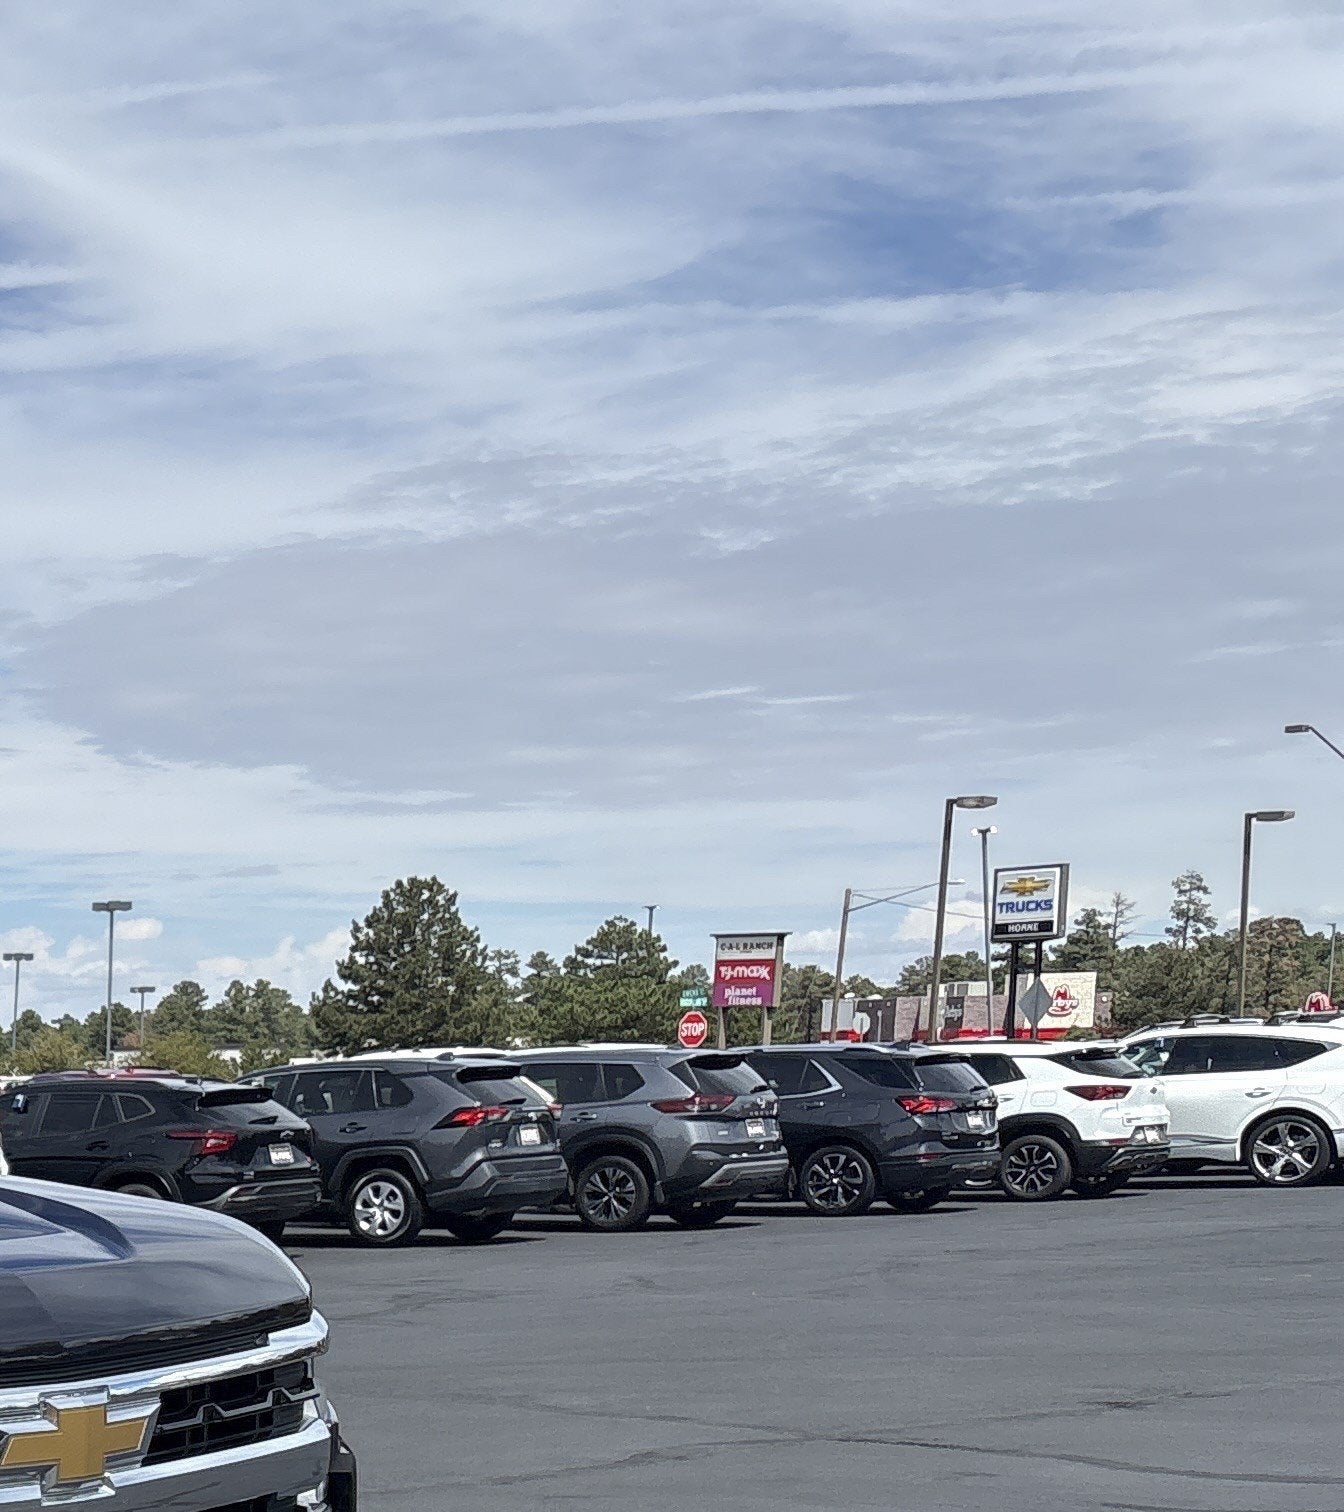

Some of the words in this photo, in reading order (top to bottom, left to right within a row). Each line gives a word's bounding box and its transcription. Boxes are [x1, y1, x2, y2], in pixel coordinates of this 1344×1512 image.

[998, 899, 1053, 914] TRUCKS
[1007, 923, 1039, 933] HORNE
[742, 941, 774, 951] RANCH
[724, 986, 757, 999] planet
[728, 996, 763, 1006] fitness
[681, 1022, 704, 1038] STOP
